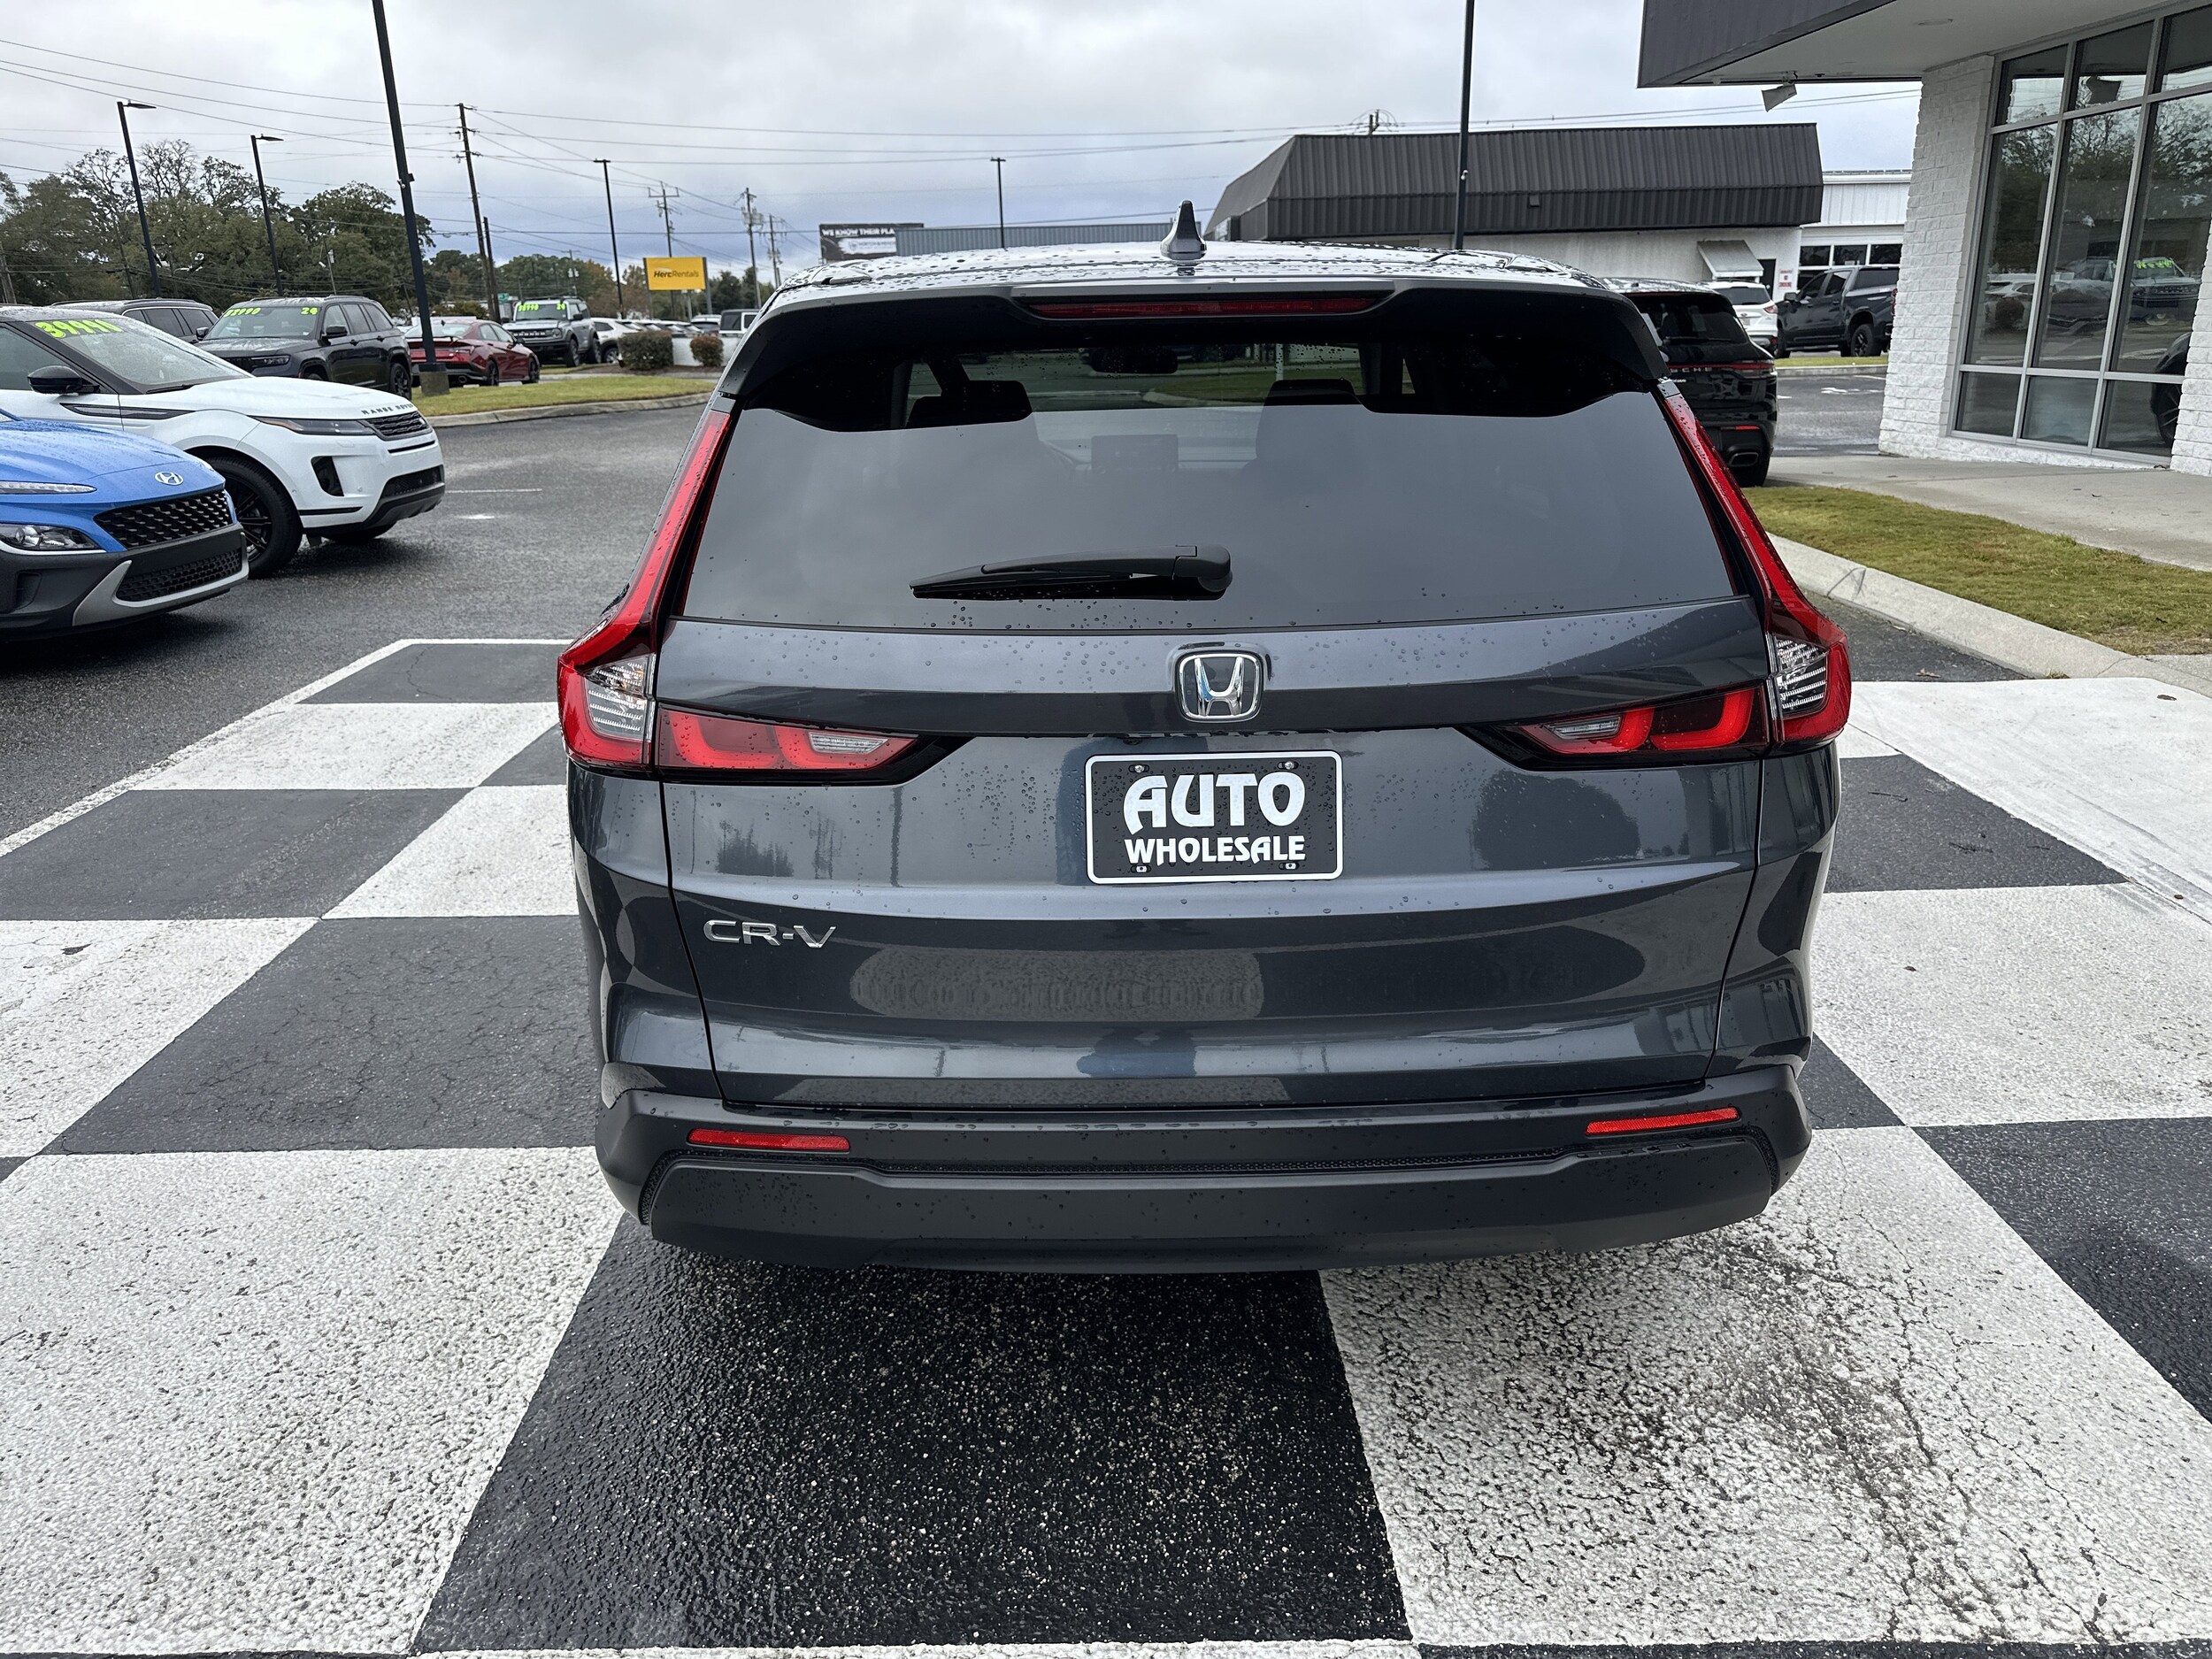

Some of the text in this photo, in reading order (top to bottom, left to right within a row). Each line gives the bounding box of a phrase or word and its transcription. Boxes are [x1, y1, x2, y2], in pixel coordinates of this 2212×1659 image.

[35, 319, 123, 339] 39990
[1124, 772, 1305, 835] AUTO
[1124, 835, 1306, 866] WHOLESALE
[703, 919, 836, 949] CR-V
